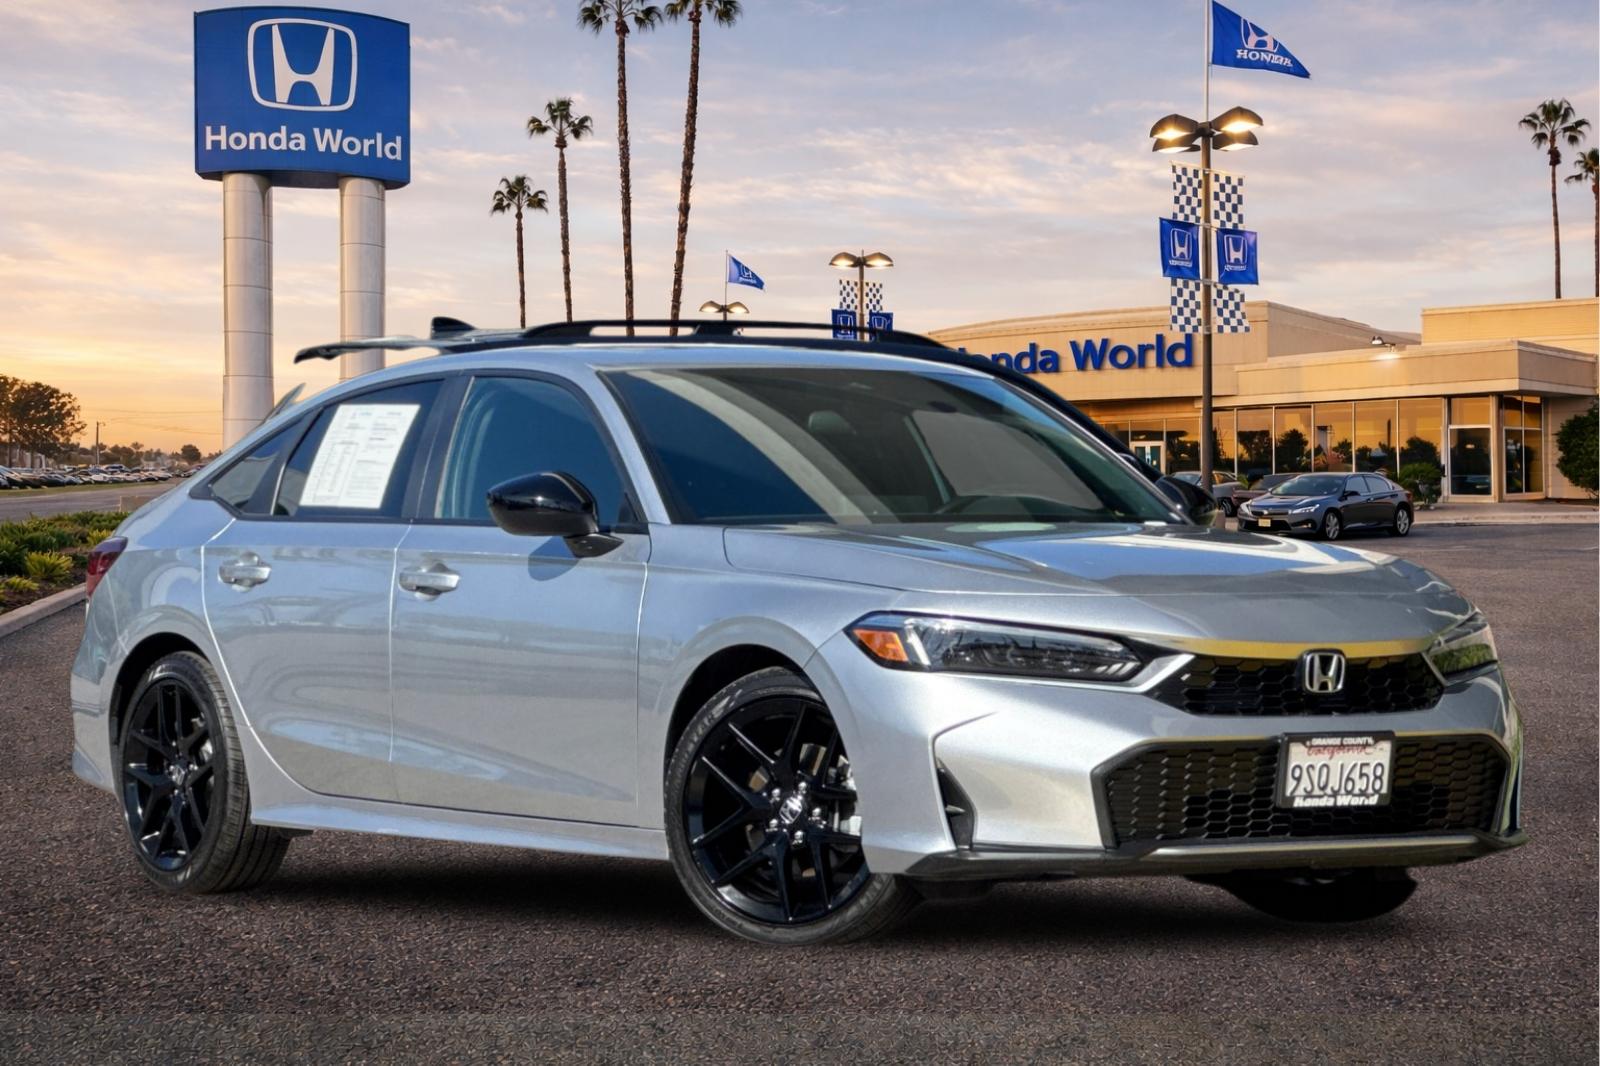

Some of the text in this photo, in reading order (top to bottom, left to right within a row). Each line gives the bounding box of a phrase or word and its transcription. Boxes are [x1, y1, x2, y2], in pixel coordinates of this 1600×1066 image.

[205, 125, 402, 160] Honda World
[958, 333, 1194, 373] nda World
[1311, 737, 1341, 745] ORANGE
[1289, 762, 1384, 796] 9SQJ658
[1293, 796, 1335, 807] Honda
